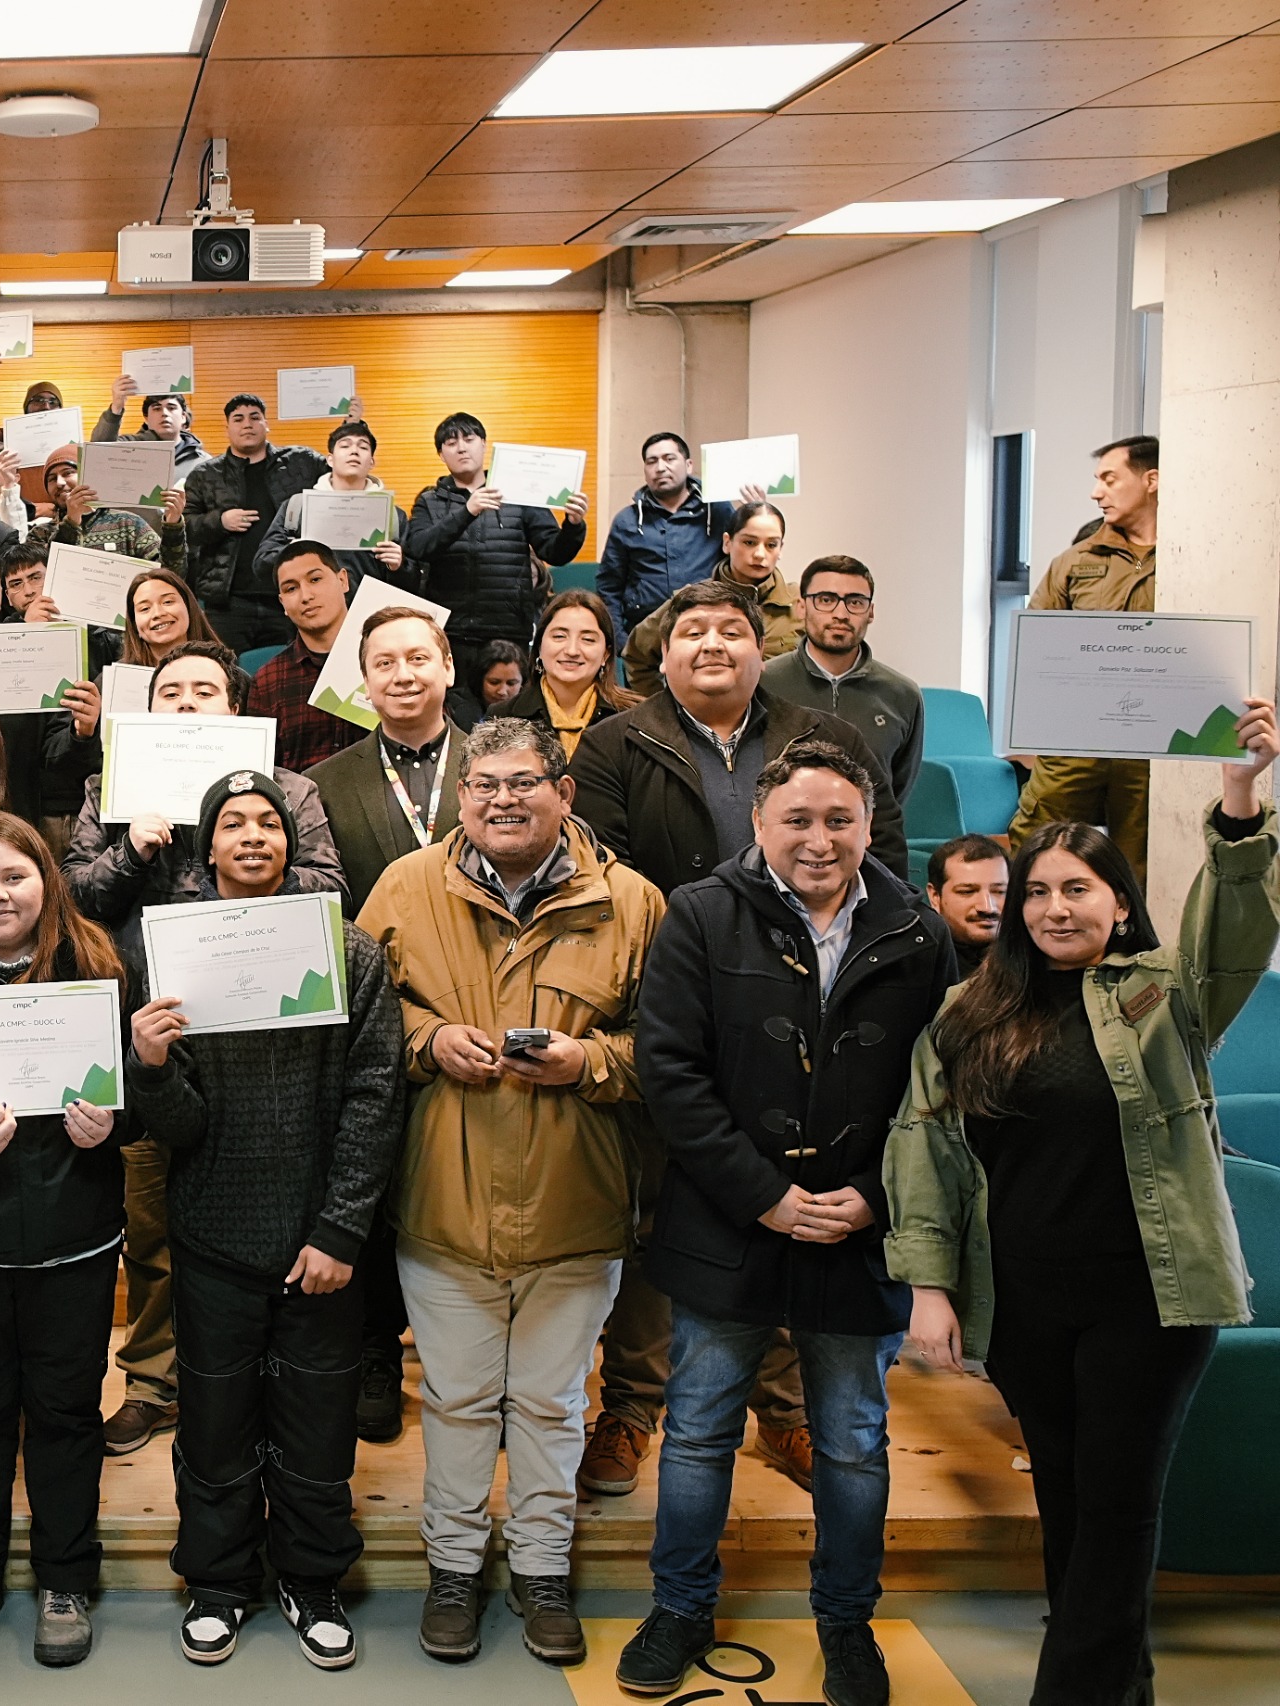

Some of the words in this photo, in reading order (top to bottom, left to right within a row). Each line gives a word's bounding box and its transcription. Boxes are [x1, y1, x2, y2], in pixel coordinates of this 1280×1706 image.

[1118, 624, 1144, 632] cmpc
[1080, 644, 1104, 652] BECA
[1106, 645, 1134, 653] CMPC
[1144, 646, 1172, 654] DUOC
[218, 932, 238, 940] CMPC
[246, 928, 266, 936] DUOC
